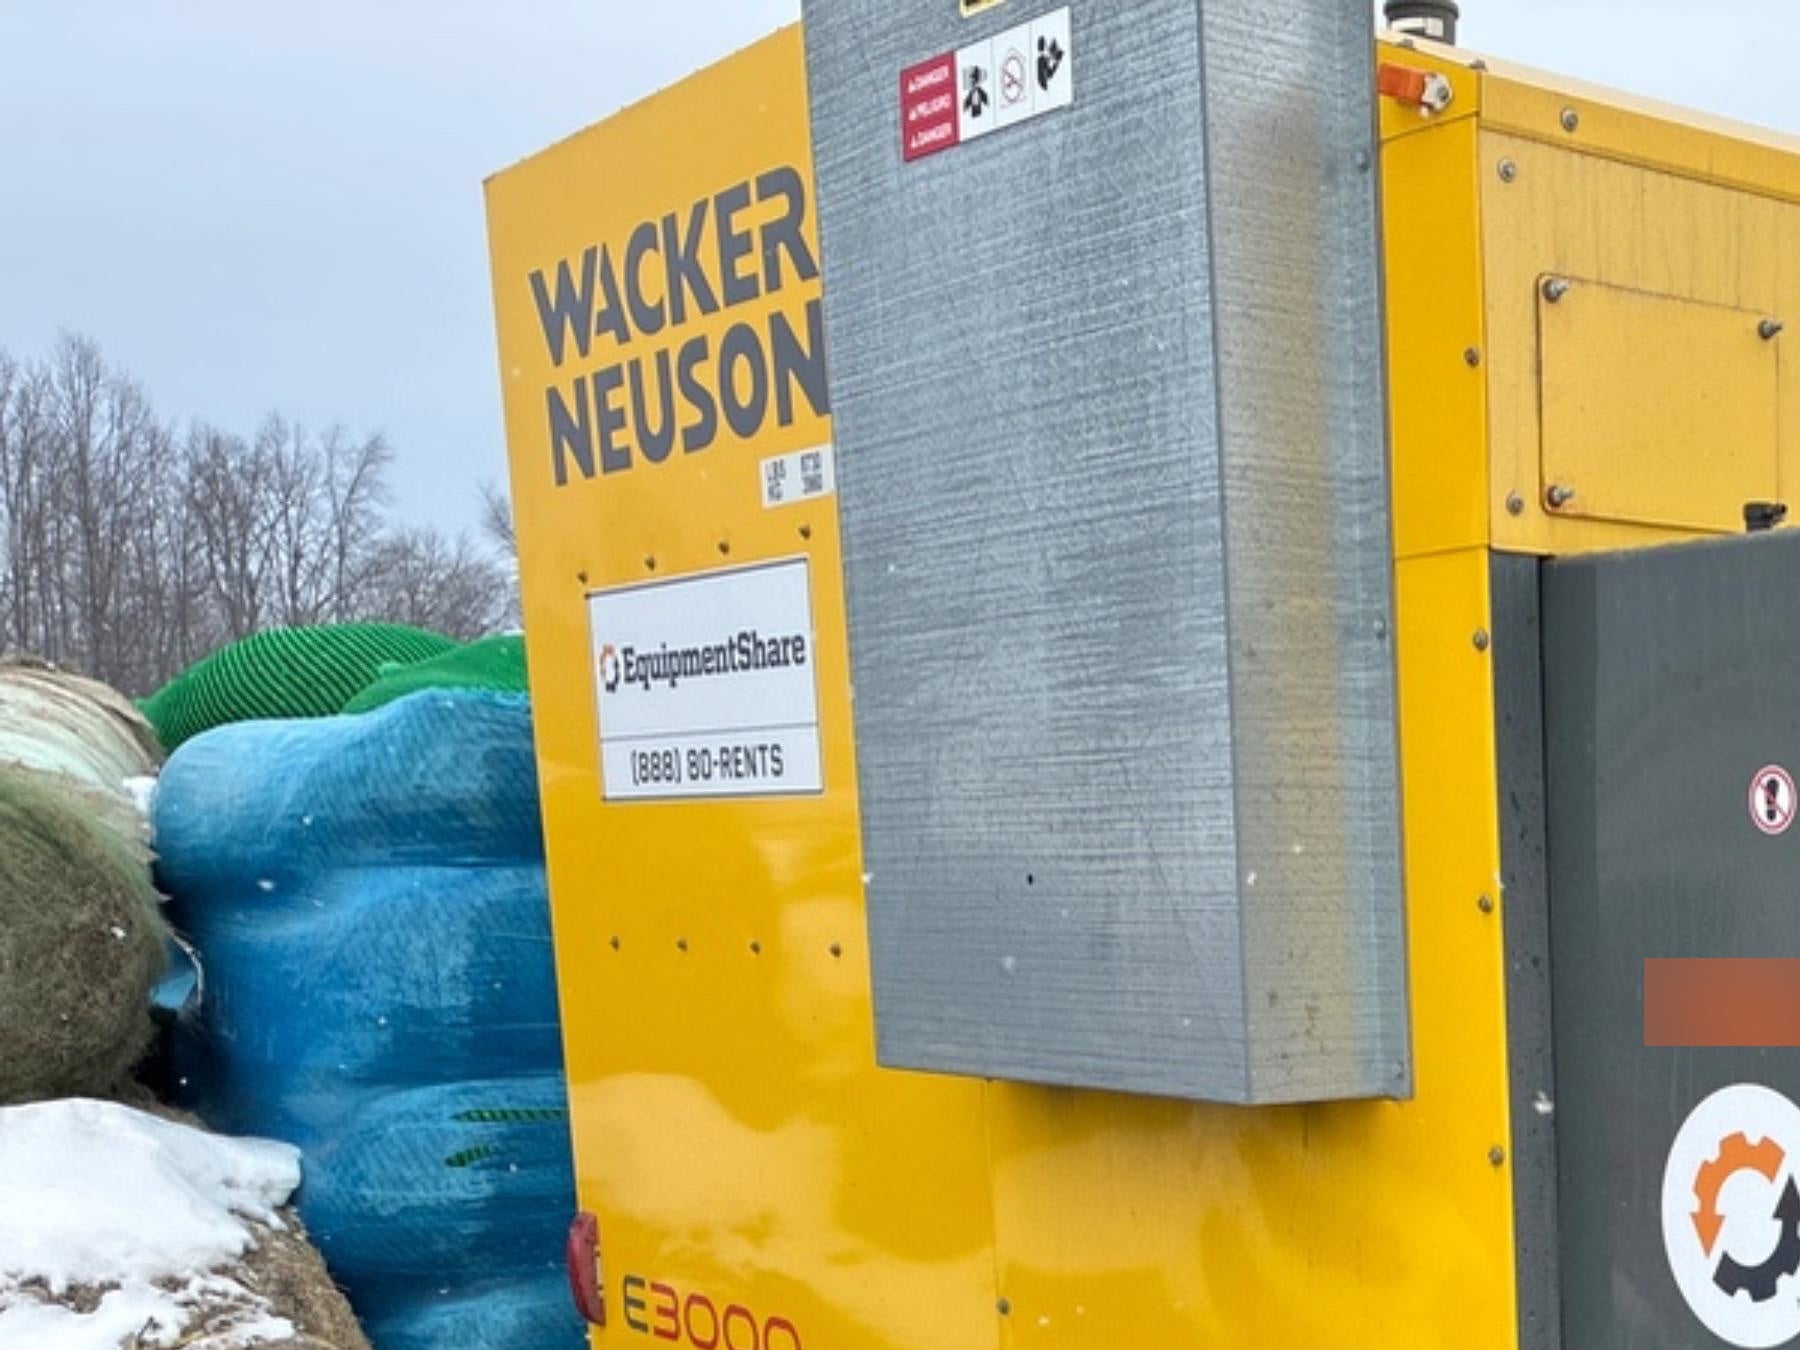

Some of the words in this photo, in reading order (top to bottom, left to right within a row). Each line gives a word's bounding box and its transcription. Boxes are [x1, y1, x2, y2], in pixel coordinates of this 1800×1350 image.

[529, 166, 821, 368] WACKER
[545, 298, 831, 487] NEUSON
[622, 631, 806, 691] EquipmentShare
[631, 750, 682, 785] (888)
[687, 743, 784, 782] 80-RENTS
